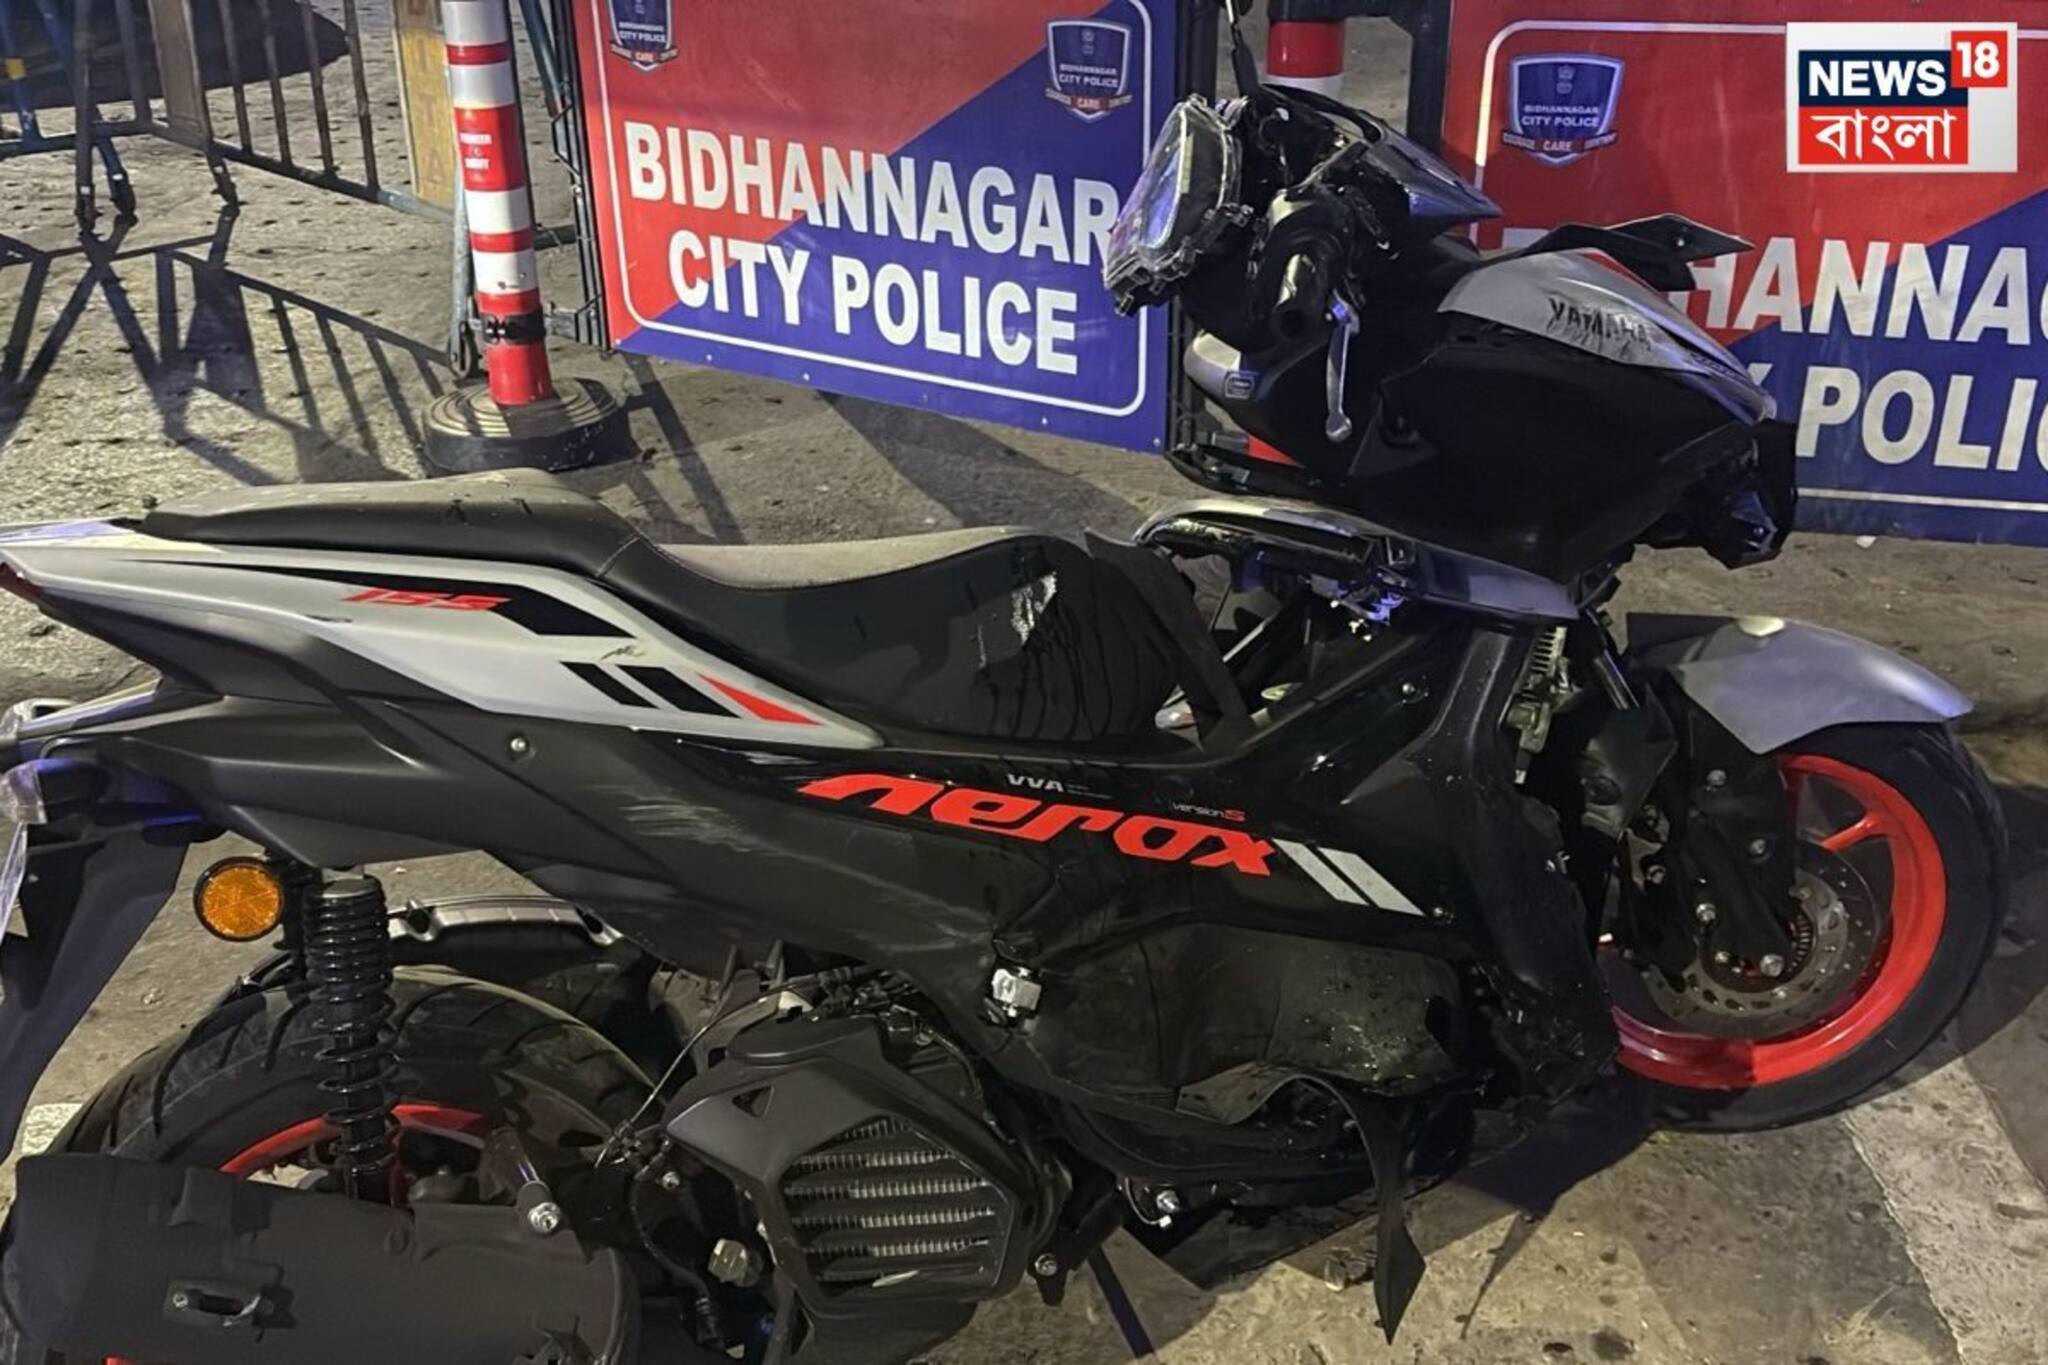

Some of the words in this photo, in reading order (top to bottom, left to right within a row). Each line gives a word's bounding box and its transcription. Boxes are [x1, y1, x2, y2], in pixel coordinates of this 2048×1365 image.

[1521, 115, 1551, 126] CITY
[1554, 116, 1600, 128] POLICE
[624, 121, 1119, 266] BIDHANNAGAR
[669, 229, 810, 326] CITY
[832, 255, 1077, 376] POLICE
[1795, 365, 2048, 473] POLI
[1006, 773, 1064, 793] VVA
